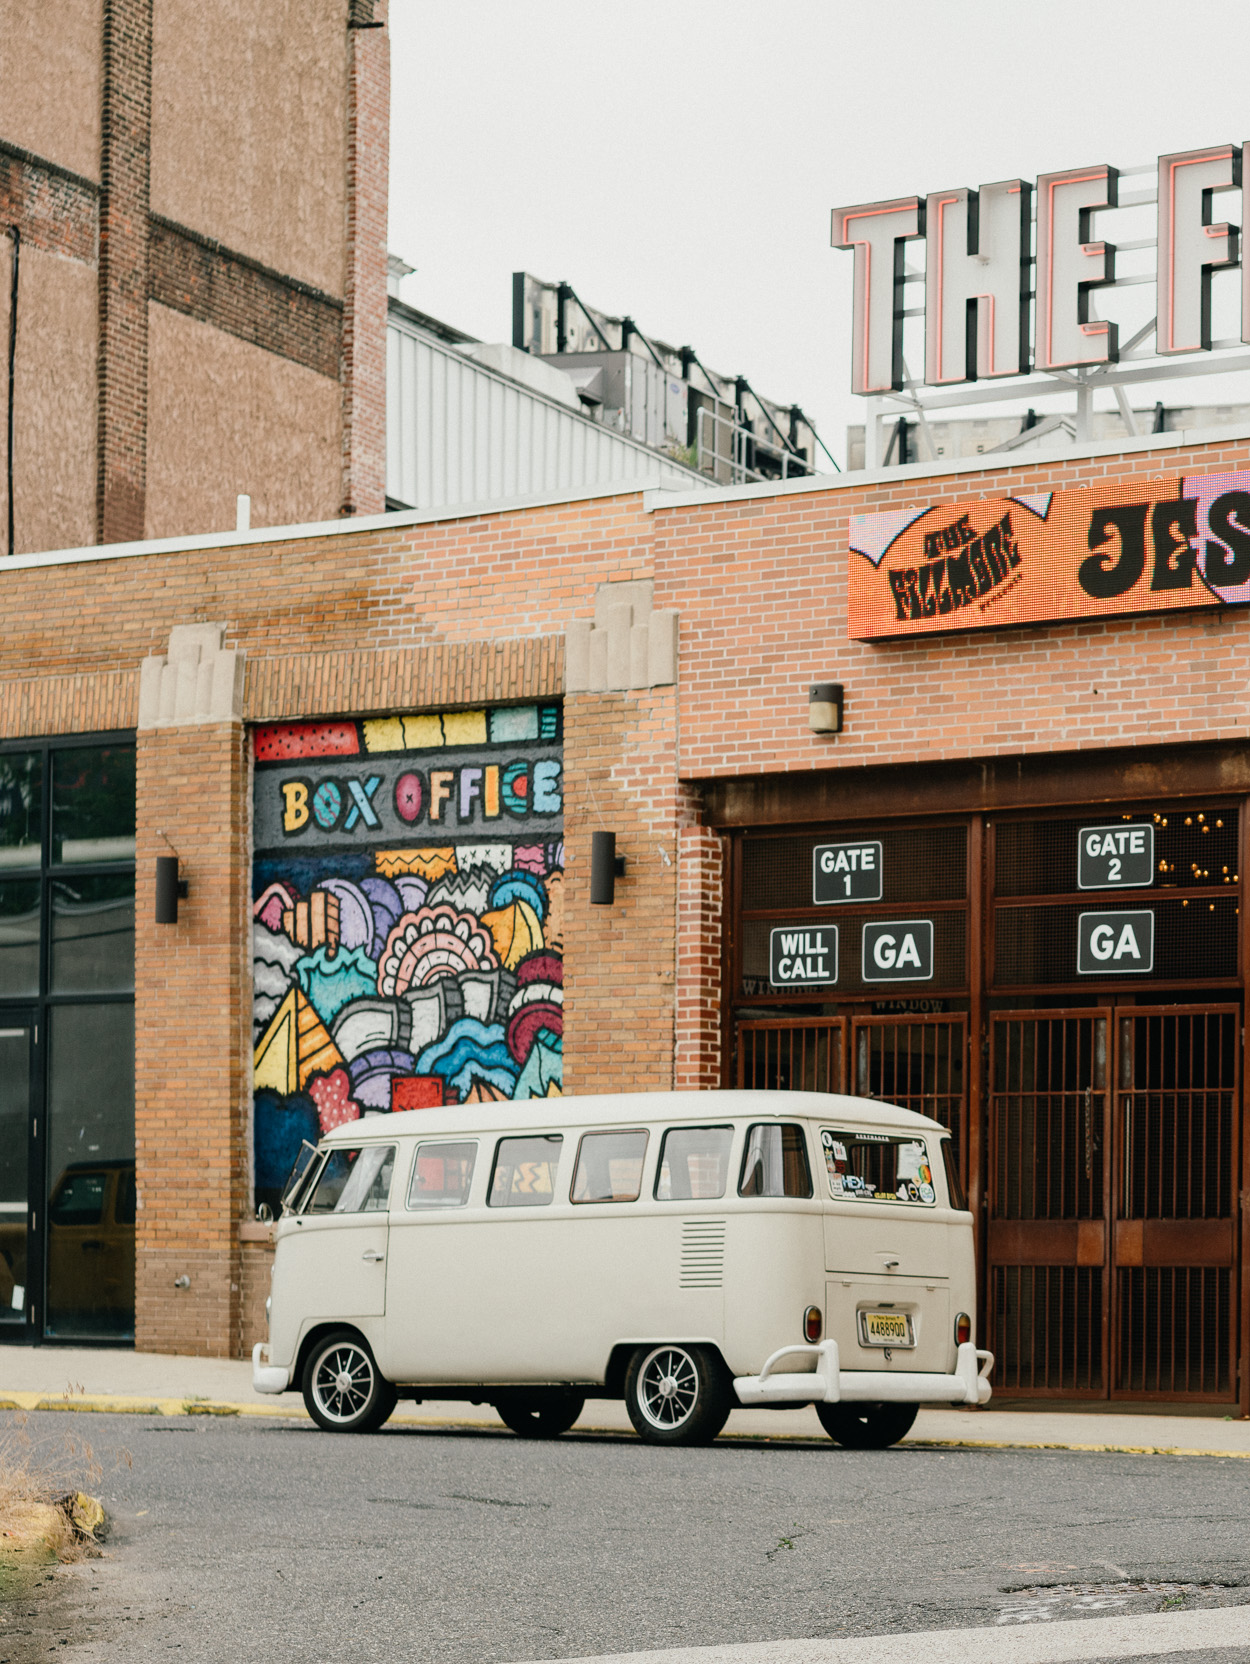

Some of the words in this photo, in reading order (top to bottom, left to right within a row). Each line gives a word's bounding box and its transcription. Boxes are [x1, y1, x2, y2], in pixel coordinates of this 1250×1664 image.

[831, 163, 1118, 395] THE
[924, 514, 978, 558] THE
[888, 512, 1022, 620] FILLMORE
[282, 776, 381, 832] BOX
[396, 761, 561, 821] OFFICE
[1086, 831, 1145, 857] GATE
[820, 848, 875, 873] GATE
[1107, 858, 1122, 881] 2
[843, 874, 852, 896] 1
[780, 932, 829, 955] WILL
[873, 934, 922, 969] GA
[1090, 924, 1141, 960] GA
[778, 956, 830, 979] CALL
